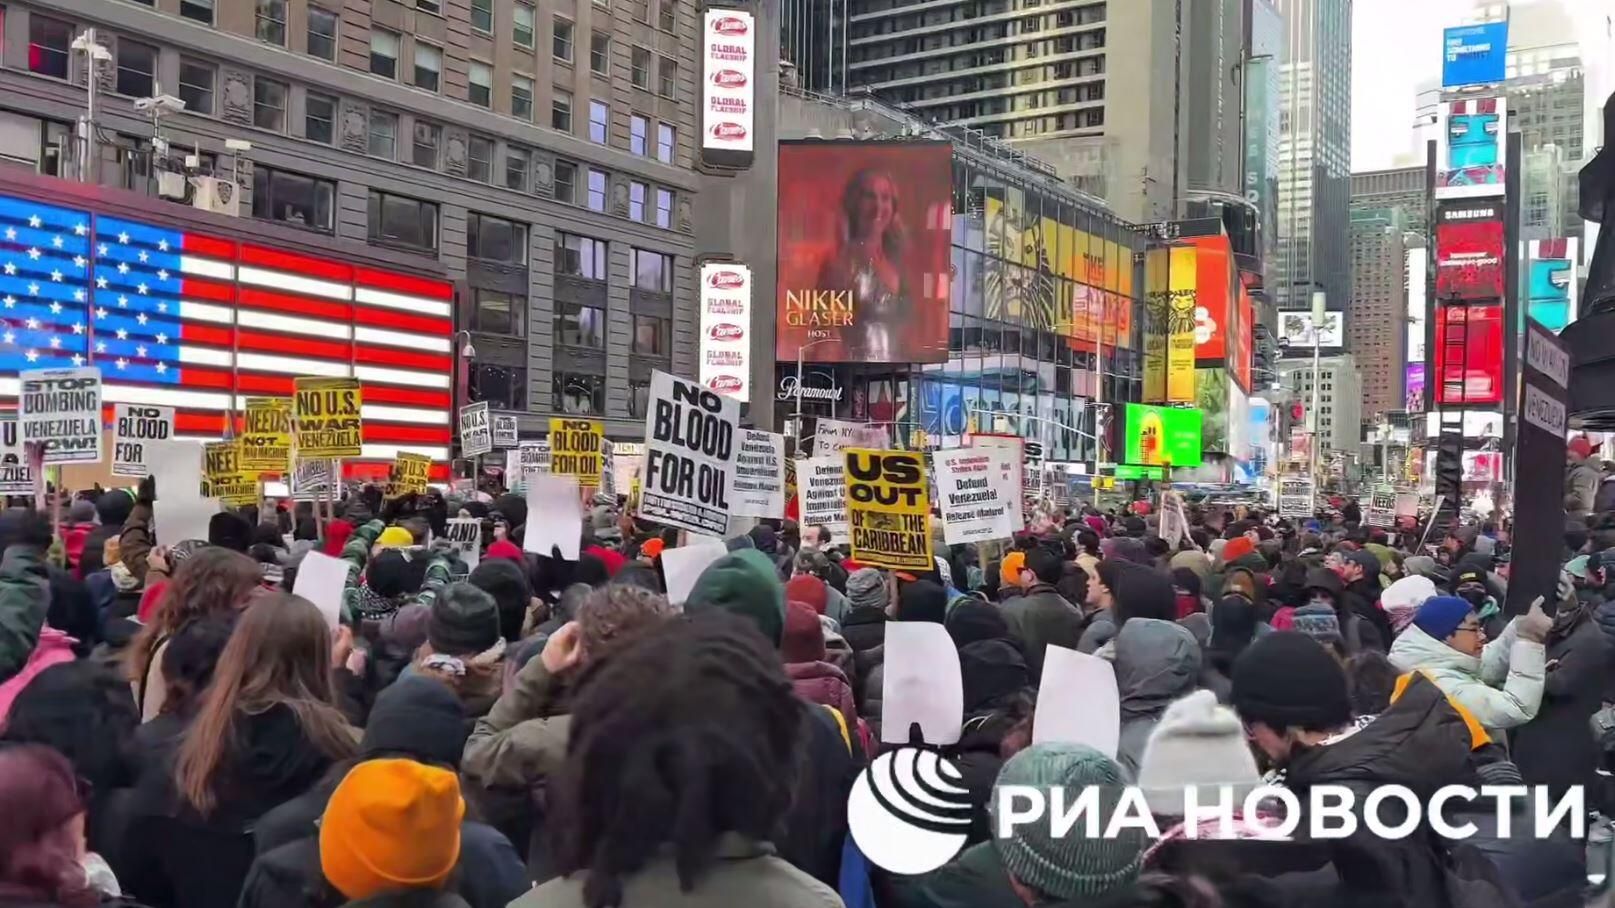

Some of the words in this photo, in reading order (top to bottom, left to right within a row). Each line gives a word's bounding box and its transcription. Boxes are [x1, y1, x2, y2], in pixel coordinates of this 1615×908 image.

[1445, 208, 1494, 219] SAMSUNG
[786, 289, 853, 311] NIKKI
[786, 311, 853, 327] GLASER
[808, 329, 831, 338] HOST
[23, 378, 97, 392] STOP
[24, 391, 97, 414] BOMBING
[297, 391, 321, 416] NO
[326, 391, 360, 416] U.S.
[673, 381, 722, 413] NO
[128, 407, 160, 417] NO
[246, 409, 290, 433] NEEDS
[24, 419, 97, 437] VENEZUELA
[118, 417, 168, 439] BLOOD
[299, 418, 360, 430] WAR
[562, 421, 591, 431] NO
[653, 398, 733, 461] BLOOD
[244, 436, 278, 446] NOT
[299, 431, 361, 448] VENEZUELA
[553, 431, 600, 453] BLOOD
[115, 443, 143, 463] FOR
[552, 454, 577, 474] FOR
[580, 456, 599, 474] OIL
[847, 453, 920, 484] US
[646, 449, 695, 499] FOR
[698, 464, 729, 510] OIL
[956, 476, 988, 490] Defend
[850, 484, 922, 506] OUT
[948, 489, 998, 505] Venezuela!
[852, 509, 864, 526] OF
[902, 514, 926, 532] THE
[854, 528, 927, 555] CARIBBEAN
